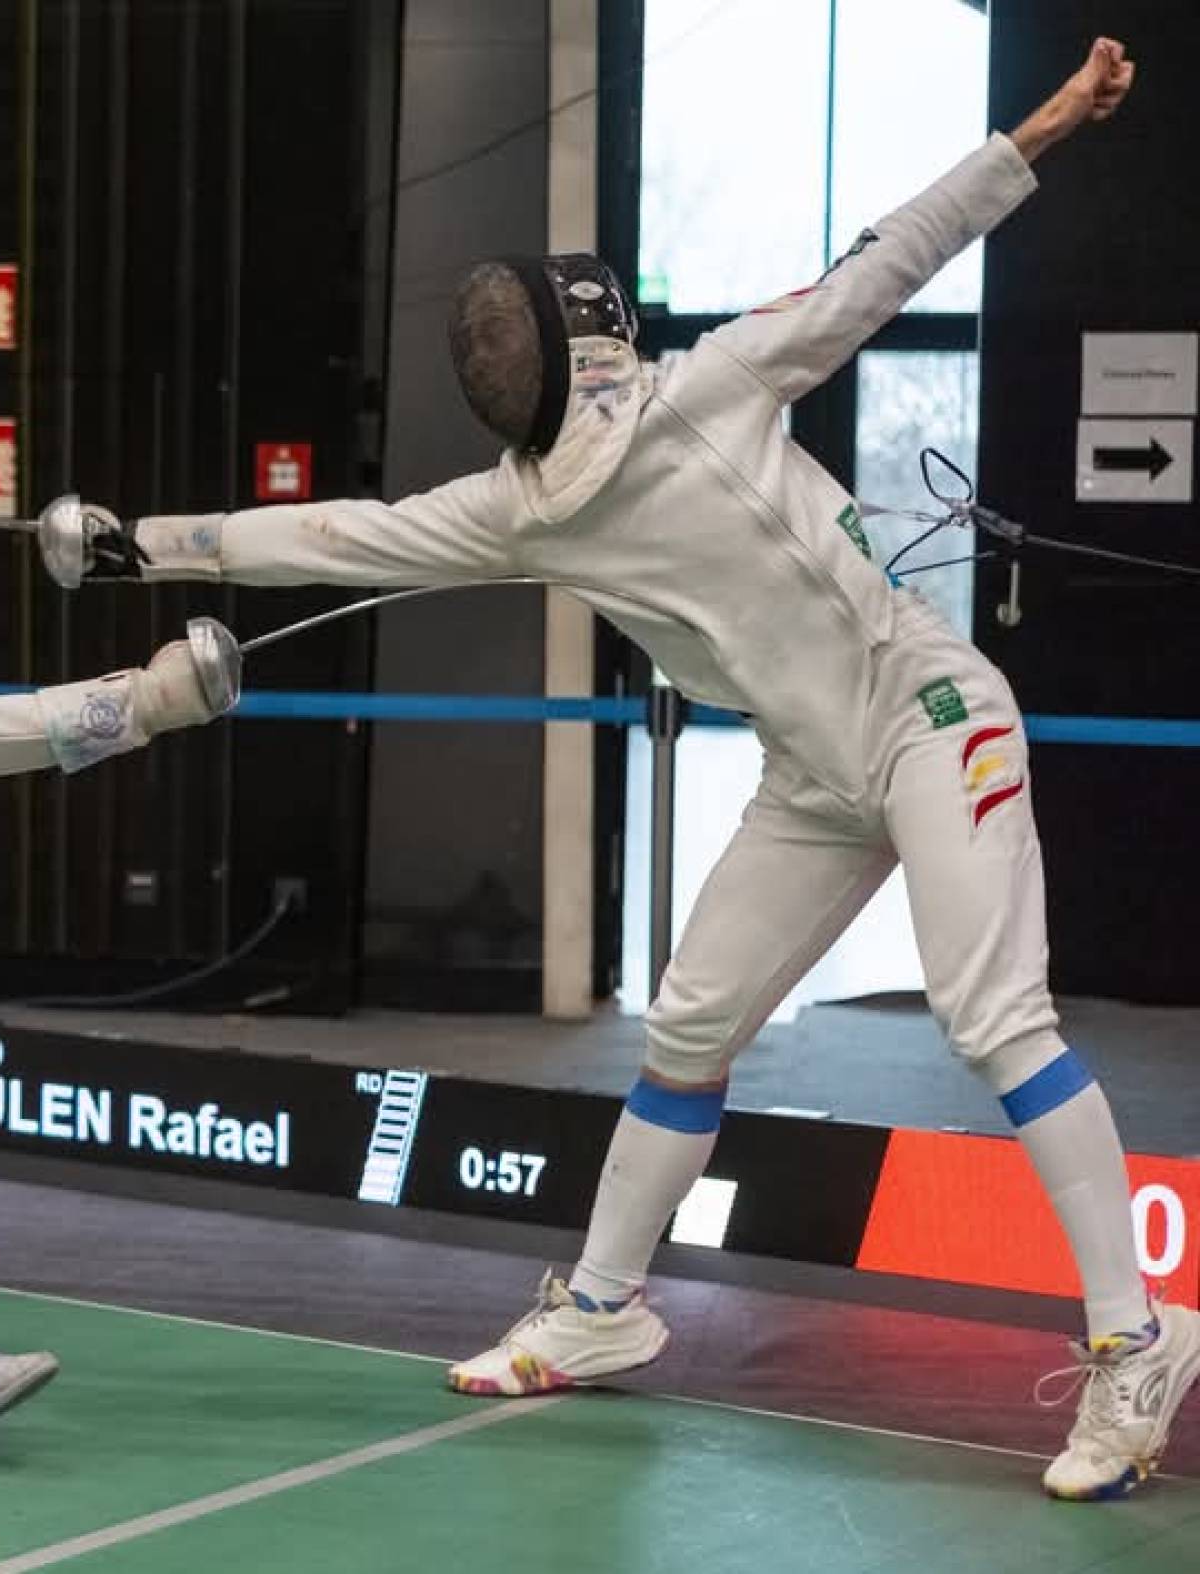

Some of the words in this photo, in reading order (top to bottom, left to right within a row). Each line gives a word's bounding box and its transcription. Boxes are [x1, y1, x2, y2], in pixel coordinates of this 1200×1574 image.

[355, 1072, 381, 1093] RD
[129, 1094, 290, 1167] Rafael
[459, 1146, 546, 1196] 0:57
[1131, 1183, 1186, 1277] 0
